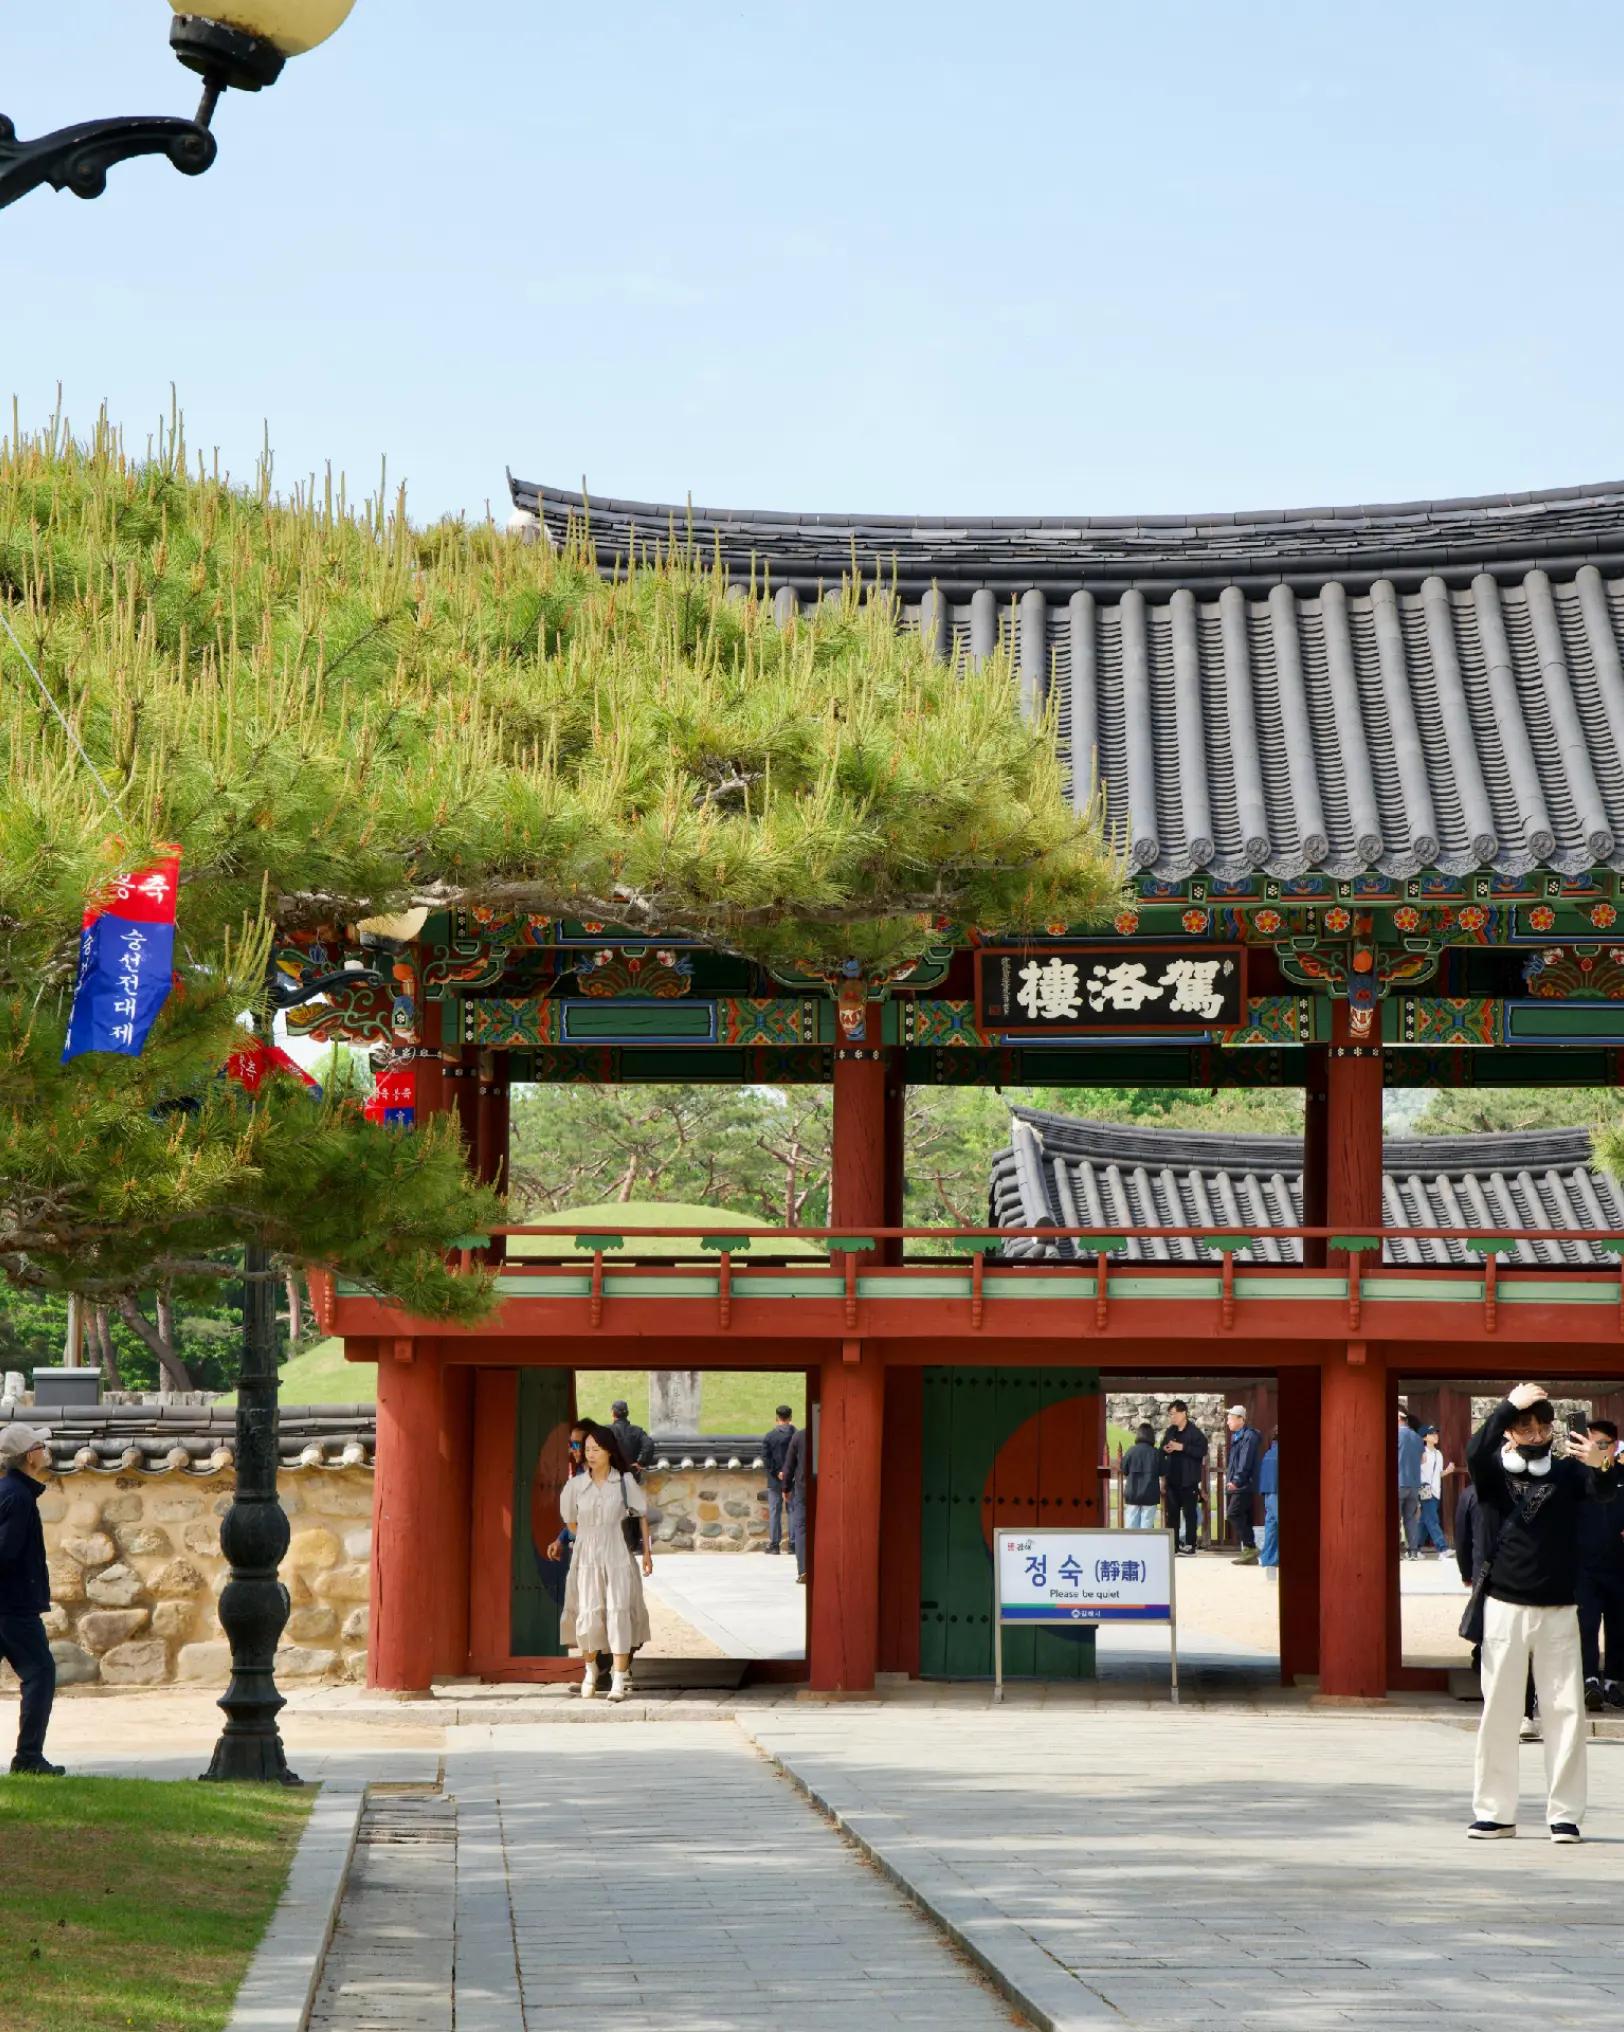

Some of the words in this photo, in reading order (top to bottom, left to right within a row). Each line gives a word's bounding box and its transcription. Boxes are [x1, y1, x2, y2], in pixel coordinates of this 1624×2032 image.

[109, 928, 148, 1046] 숭선전대제
[1050, 1589, 1079, 1598] Please
[1082, 1589, 1094, 1598] be
[1096, 1590, 1120, 1600] quiet
